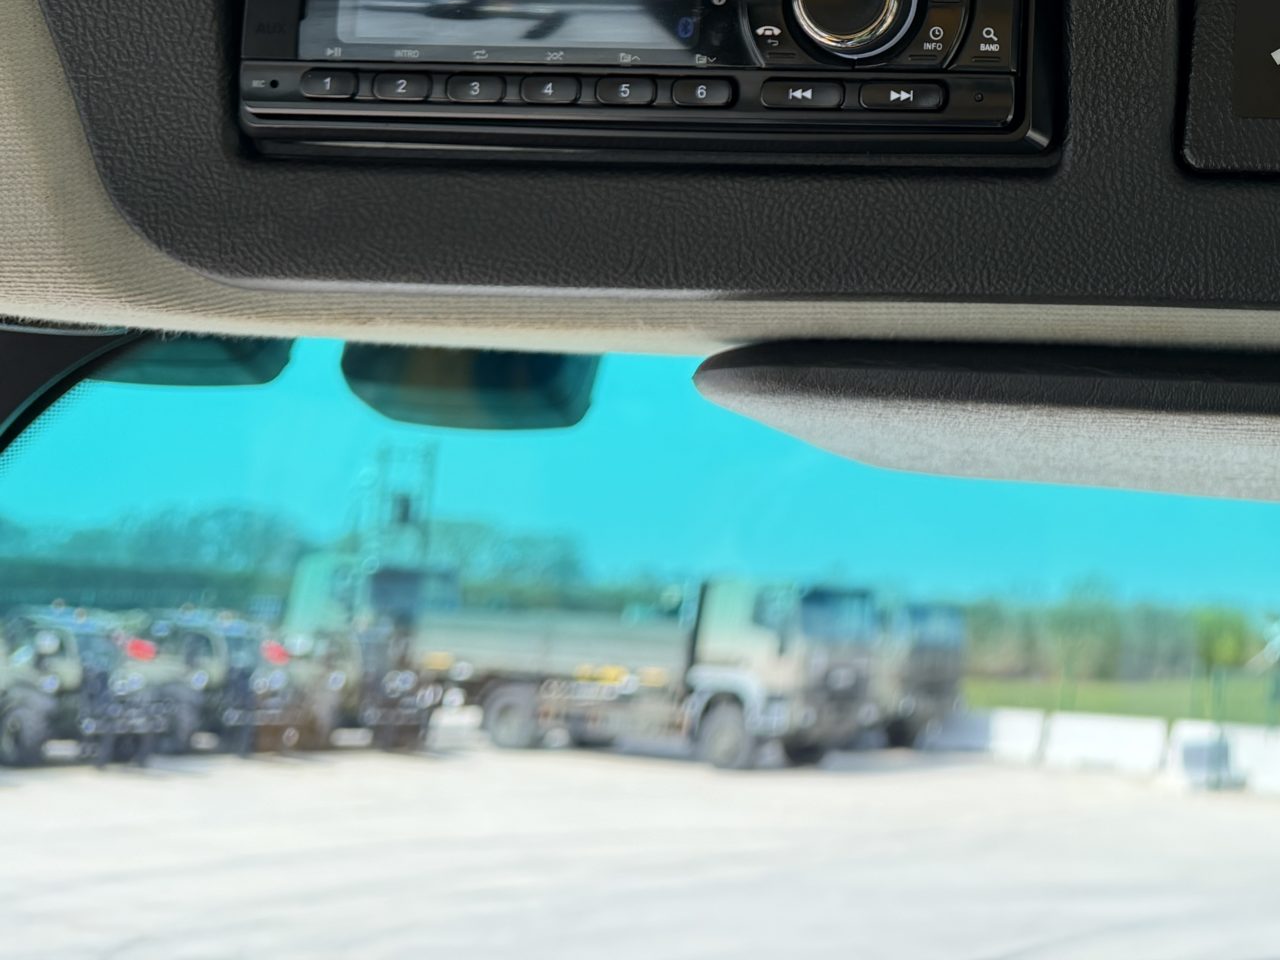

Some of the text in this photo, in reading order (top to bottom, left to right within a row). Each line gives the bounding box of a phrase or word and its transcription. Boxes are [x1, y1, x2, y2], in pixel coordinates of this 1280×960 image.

[980, 43, 1000, 52] BAND
[323, 77, 332, 90] 1
[397, 79, 408, 93] 2
[469, 81, 481, 96] 3
[542, 82, 553, 96] 4
[620, 83, 631, 97] 5
[697, 85, 707, 98] 6
